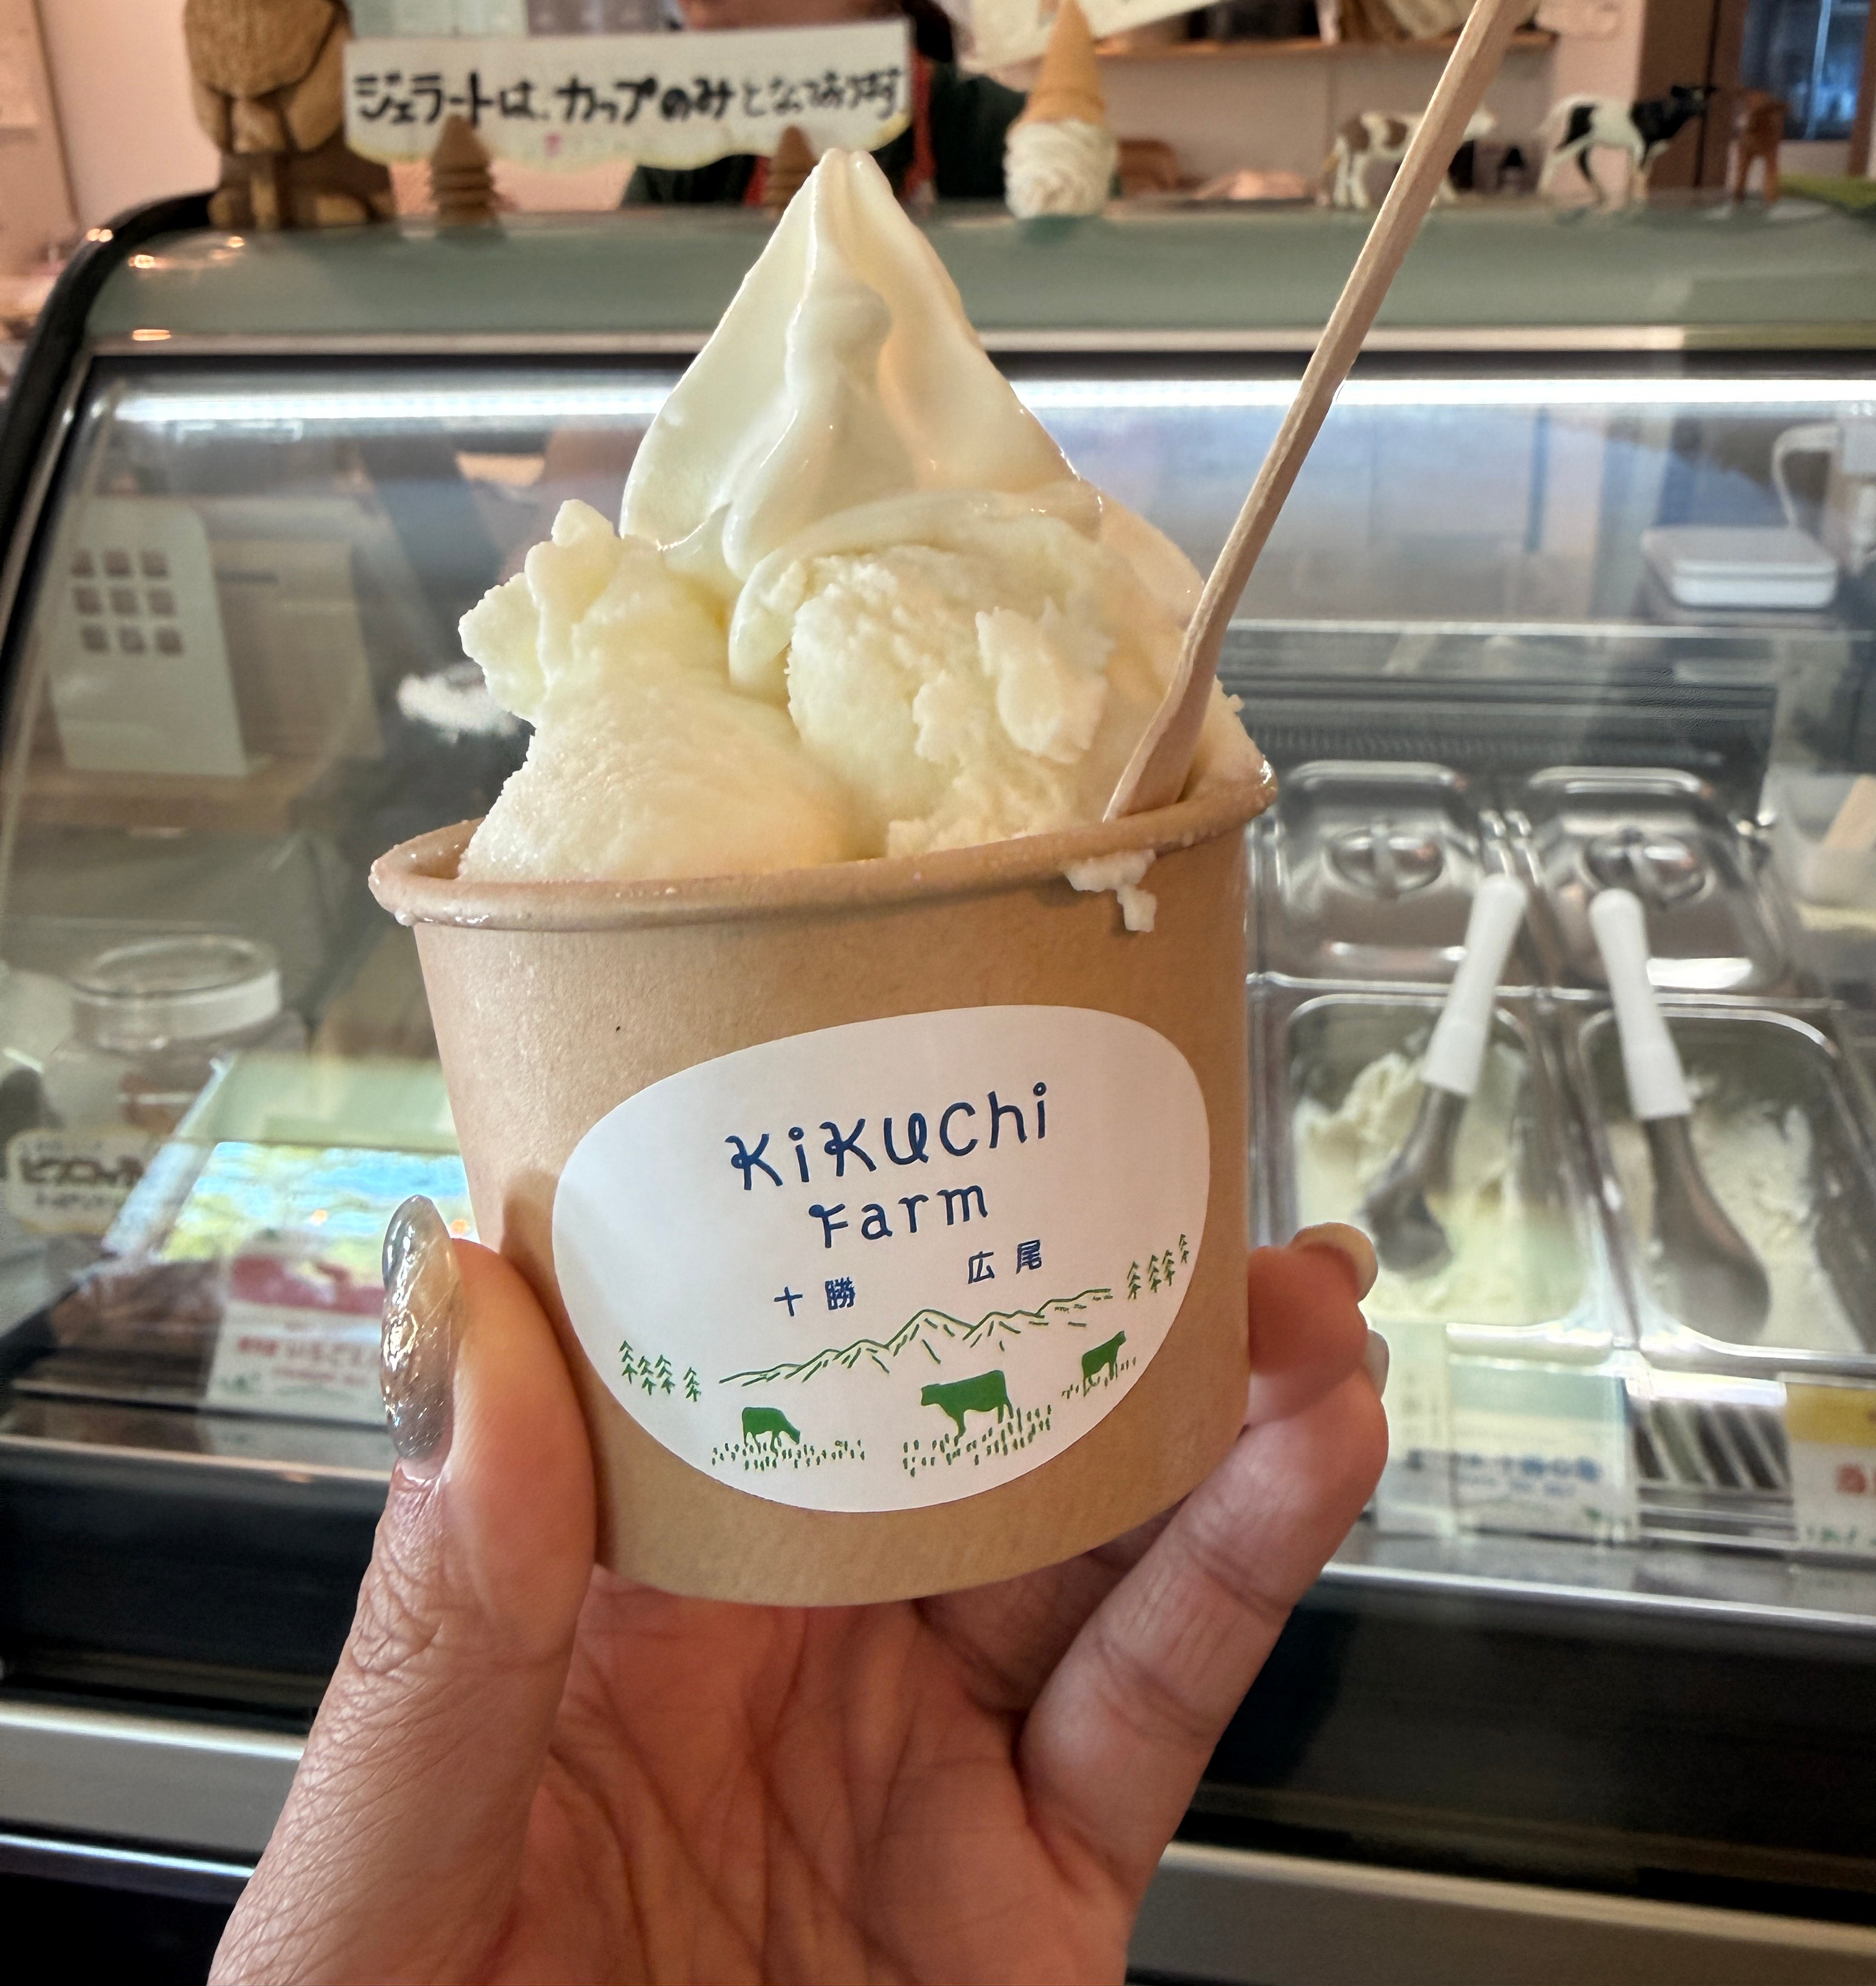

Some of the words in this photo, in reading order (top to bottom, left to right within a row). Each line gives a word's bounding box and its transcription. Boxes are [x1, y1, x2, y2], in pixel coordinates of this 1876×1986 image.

[808, 1185, 988, 1249] Farm
[774, 1276, 856, 1317] 十勝
[967, 1239, 1043, 1285] 広尾
